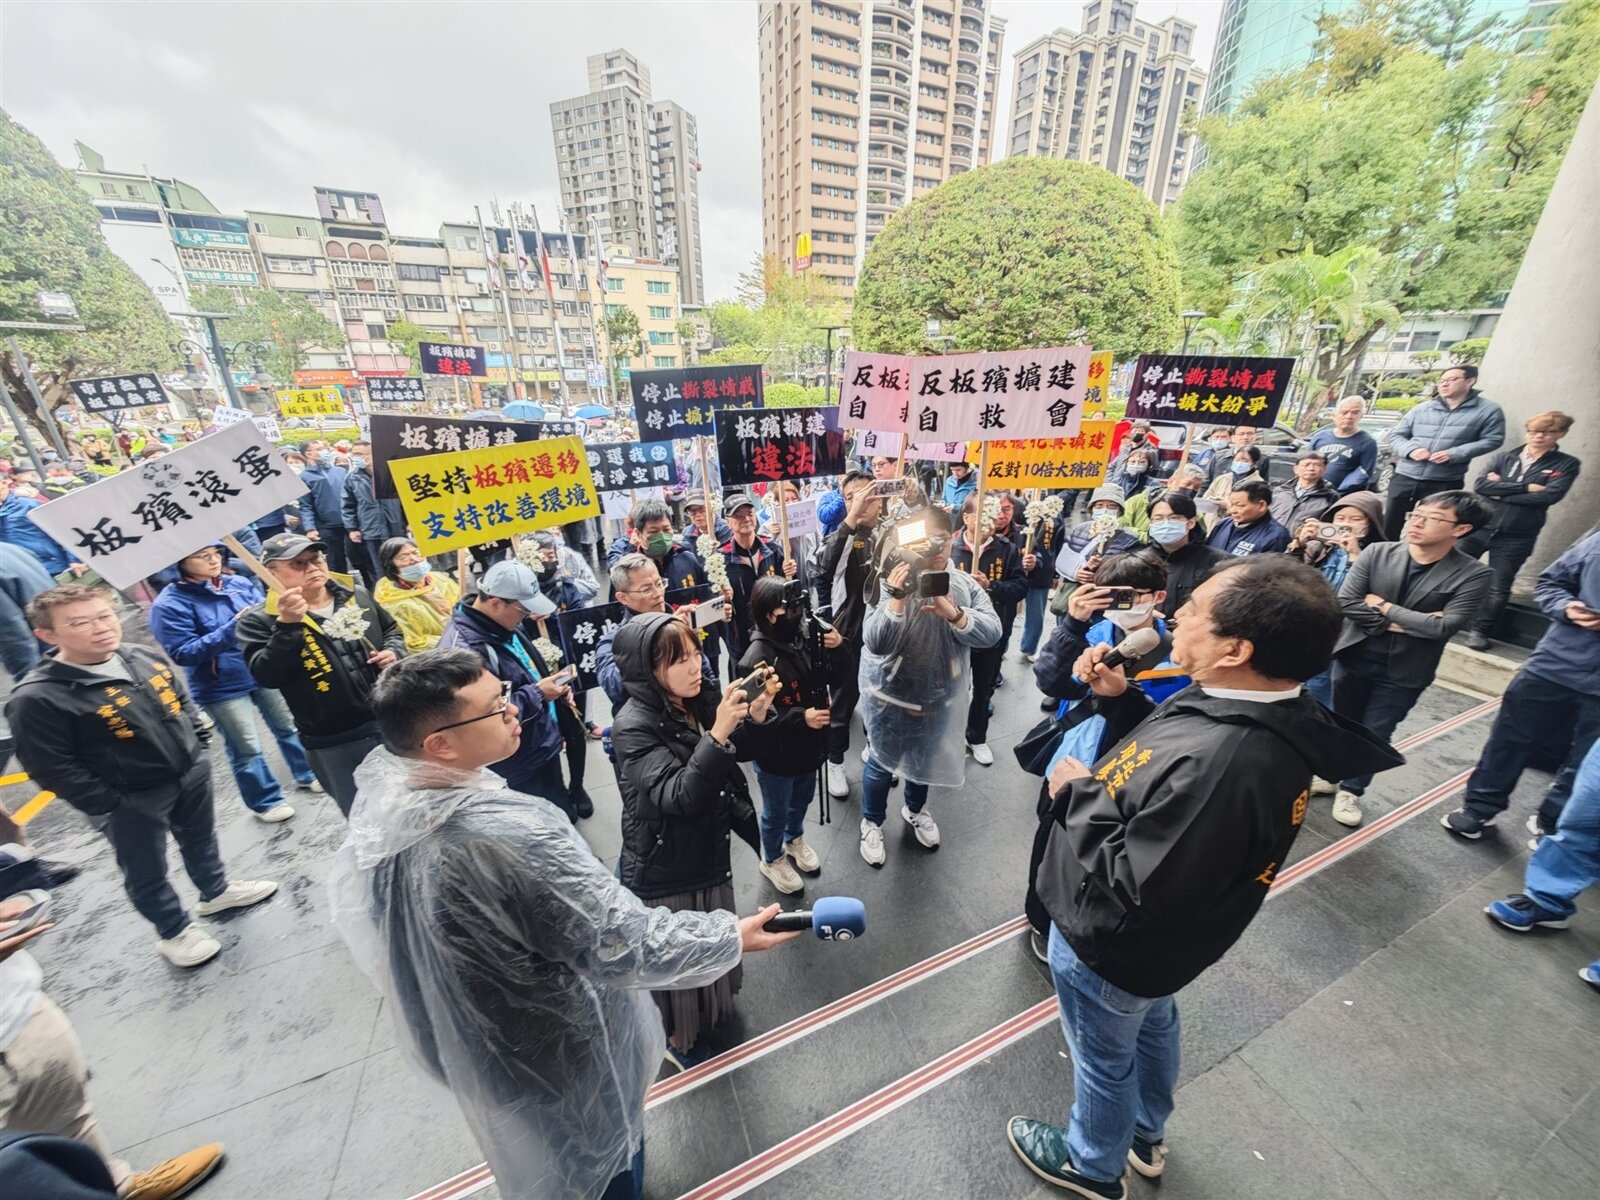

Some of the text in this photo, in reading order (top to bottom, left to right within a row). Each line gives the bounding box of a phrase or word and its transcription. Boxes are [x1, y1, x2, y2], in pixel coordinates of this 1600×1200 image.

[157, 286, 178, 294] SPA
[437, 357, 472, 376] 違法
[852, 364, 909, 392] 反板
[918, 359, 1077, 397] 反板殯擴建
[1142, 364, 1277, 392] 停止撕裂情感
[296, 391, 326, 403] 反對
[641, 375, 756, 404] 停止撕裂情感
[1136, 388, 1268, 416] 停止擴大紛爭
[735, 411, 826, 440] 板殯擴建
[919, 398, 1077, 433] 自救會
[399, 422, 518, 451] 板殯擴建
[751, 441, 817, 481] 違法
[988, 460, 1103, 479] 反對10倍大殯館
[406, 449, 581, 503] 堅持板殯遷移
[72, 445, 281, 558] 板殯滾蛋
[422, 482, 591, 540] 支持改善環境
